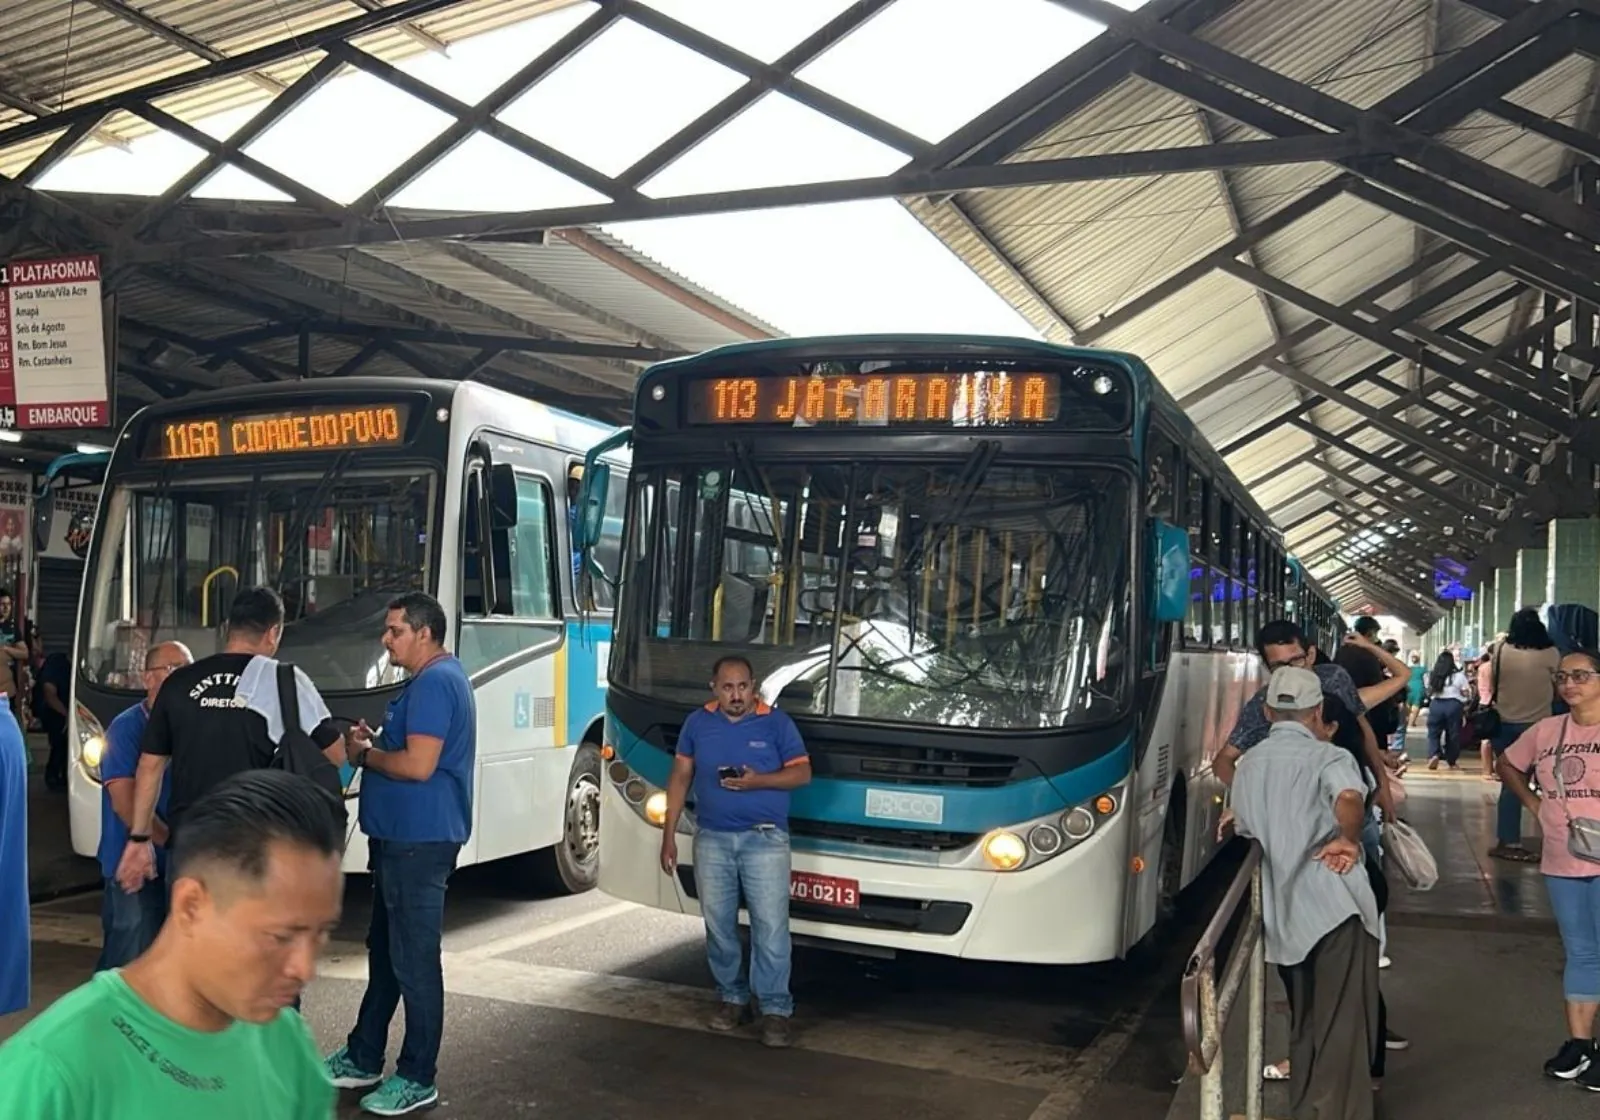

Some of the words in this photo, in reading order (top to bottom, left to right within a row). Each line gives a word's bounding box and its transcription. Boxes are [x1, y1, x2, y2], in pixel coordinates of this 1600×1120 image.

[13, 260, 97, 283] PLATAFORMA
[14, 290, 34, 300] Santa
[72, 286, 88, 296] Acre
[16, 305, 39, 319] Amapá
[16, 324, 30, 334] Seis
[31, 322, 40, 333] de
[41, 322, 66, 335] Agosto
[32, 340, 48, 350] Bom
[49, 340, 67, 350] Jesus
[33, 354, 73, 367] Castanheira
[713, 378, 758, 419] 113
[29, 405, 99, 427] EMBARQUE
